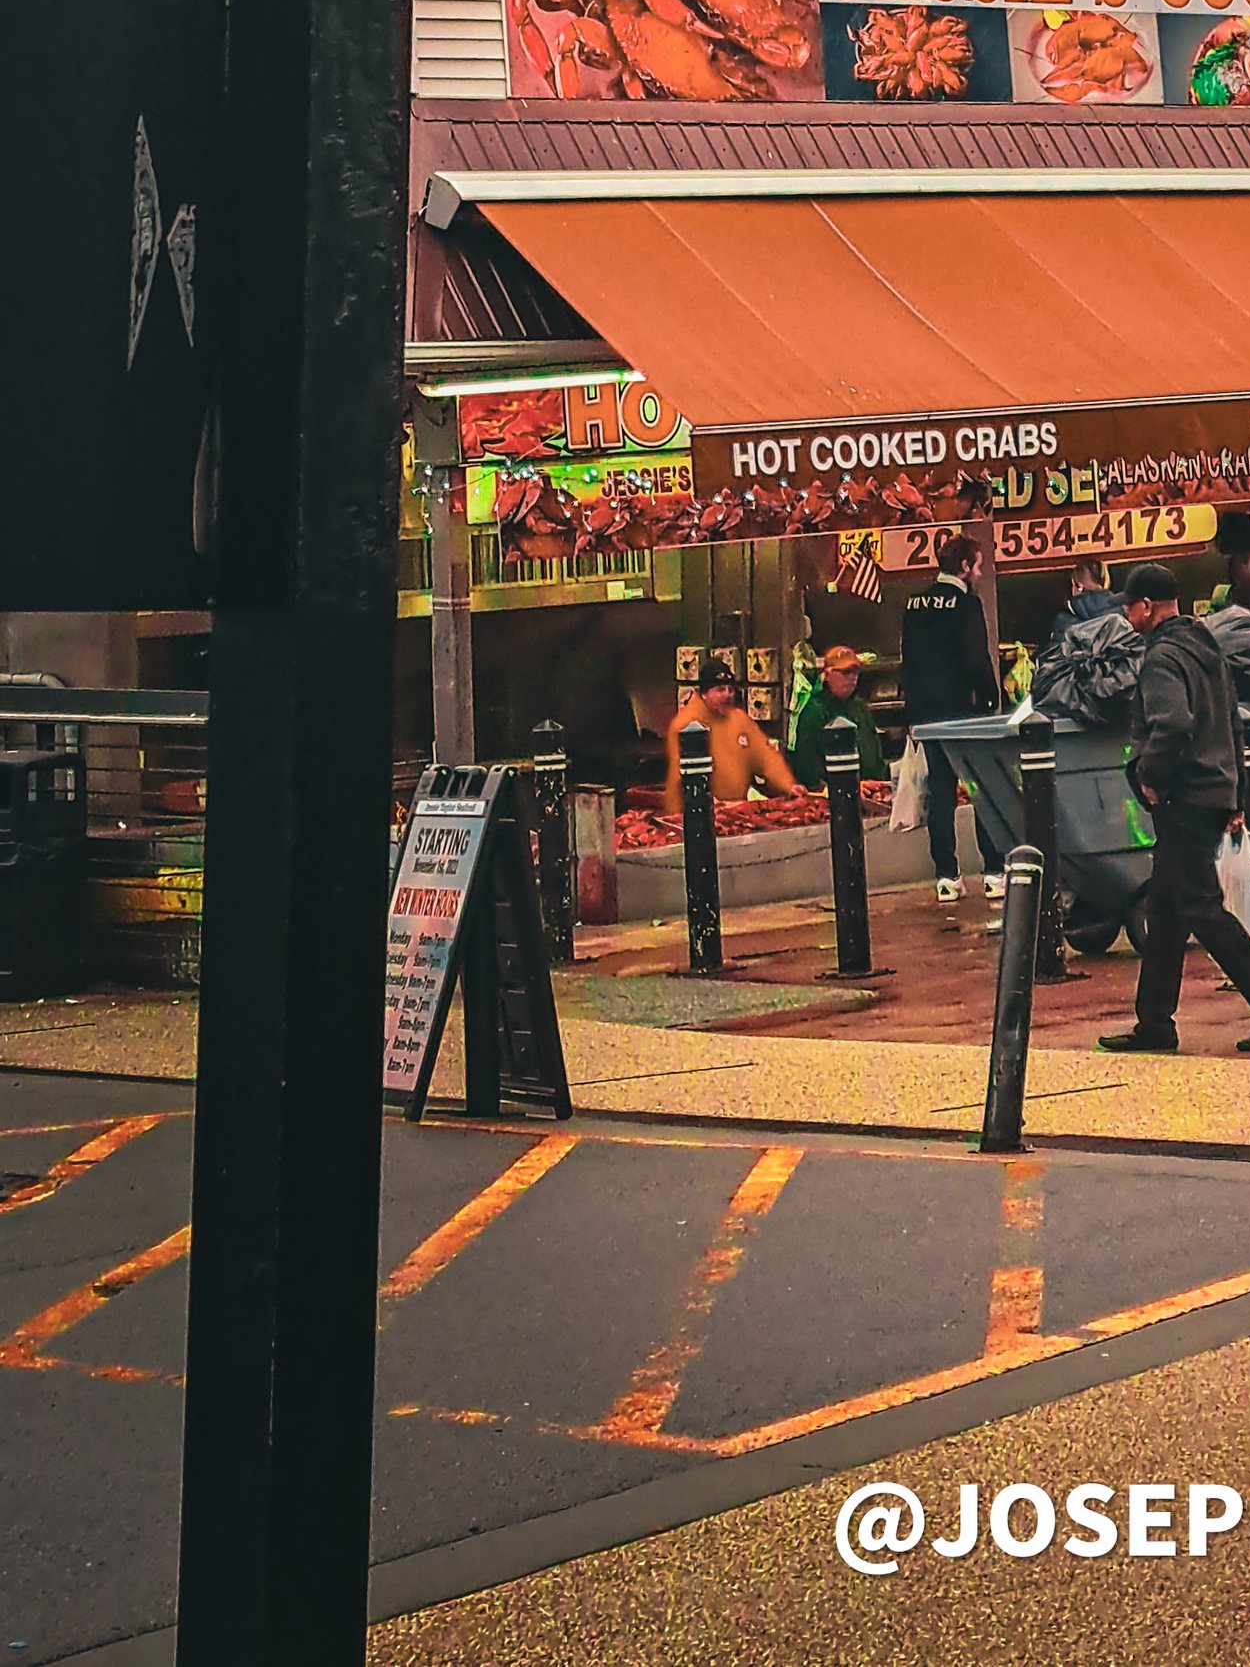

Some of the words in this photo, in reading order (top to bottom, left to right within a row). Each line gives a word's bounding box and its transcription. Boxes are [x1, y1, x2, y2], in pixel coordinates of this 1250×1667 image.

[733, 437, 802, 477] HOT
[811, 430, 947, 472] COOKED
[955, 422, 1057, 462] CRABS
[601, 465, 692, 499] JESSIE'S
[414, 827, 471, 856] STARTING
